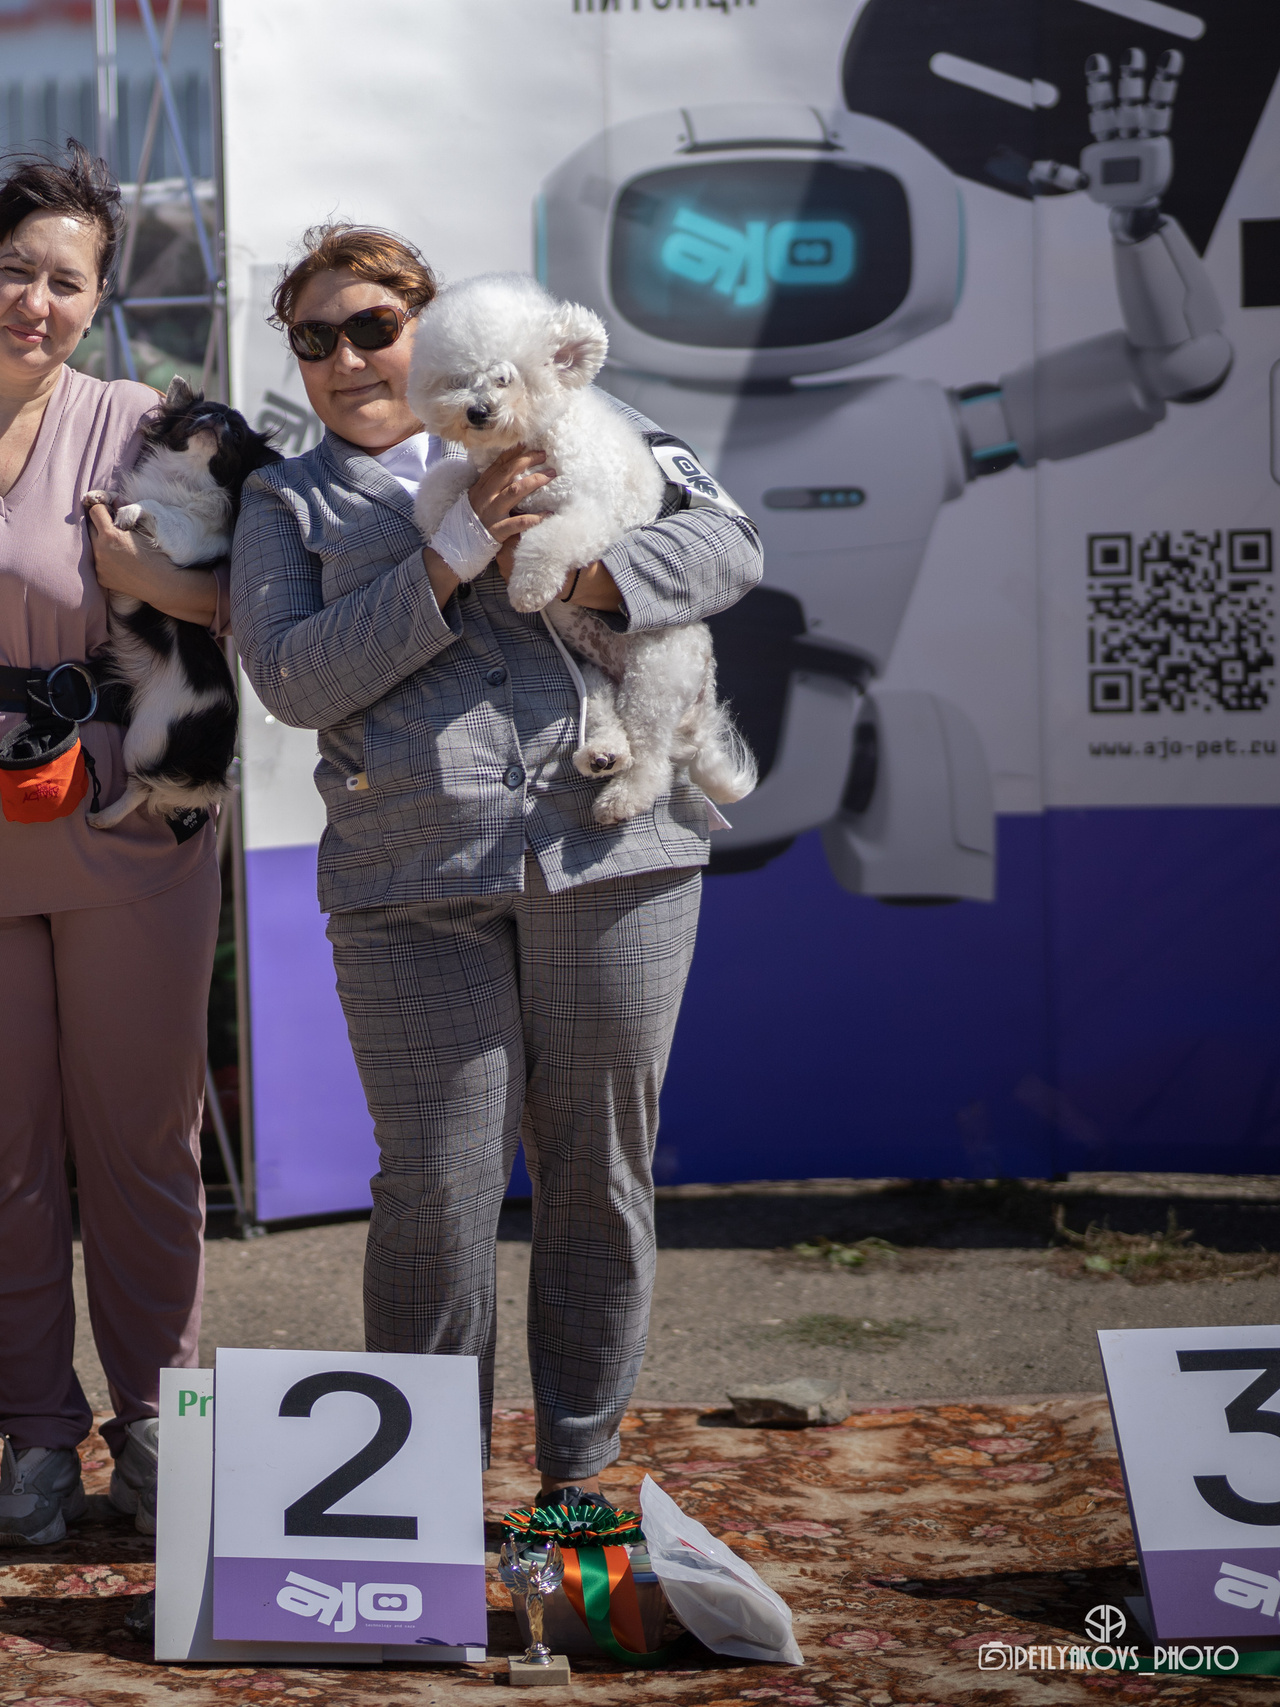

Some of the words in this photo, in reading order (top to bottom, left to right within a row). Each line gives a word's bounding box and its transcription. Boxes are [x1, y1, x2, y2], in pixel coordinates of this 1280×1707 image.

[1088, 737, 1276, 760] www.ajo-pet.ru
[278, 1371, 419, 1540] 2
[1176, 1348, 1280, 1526] 3
